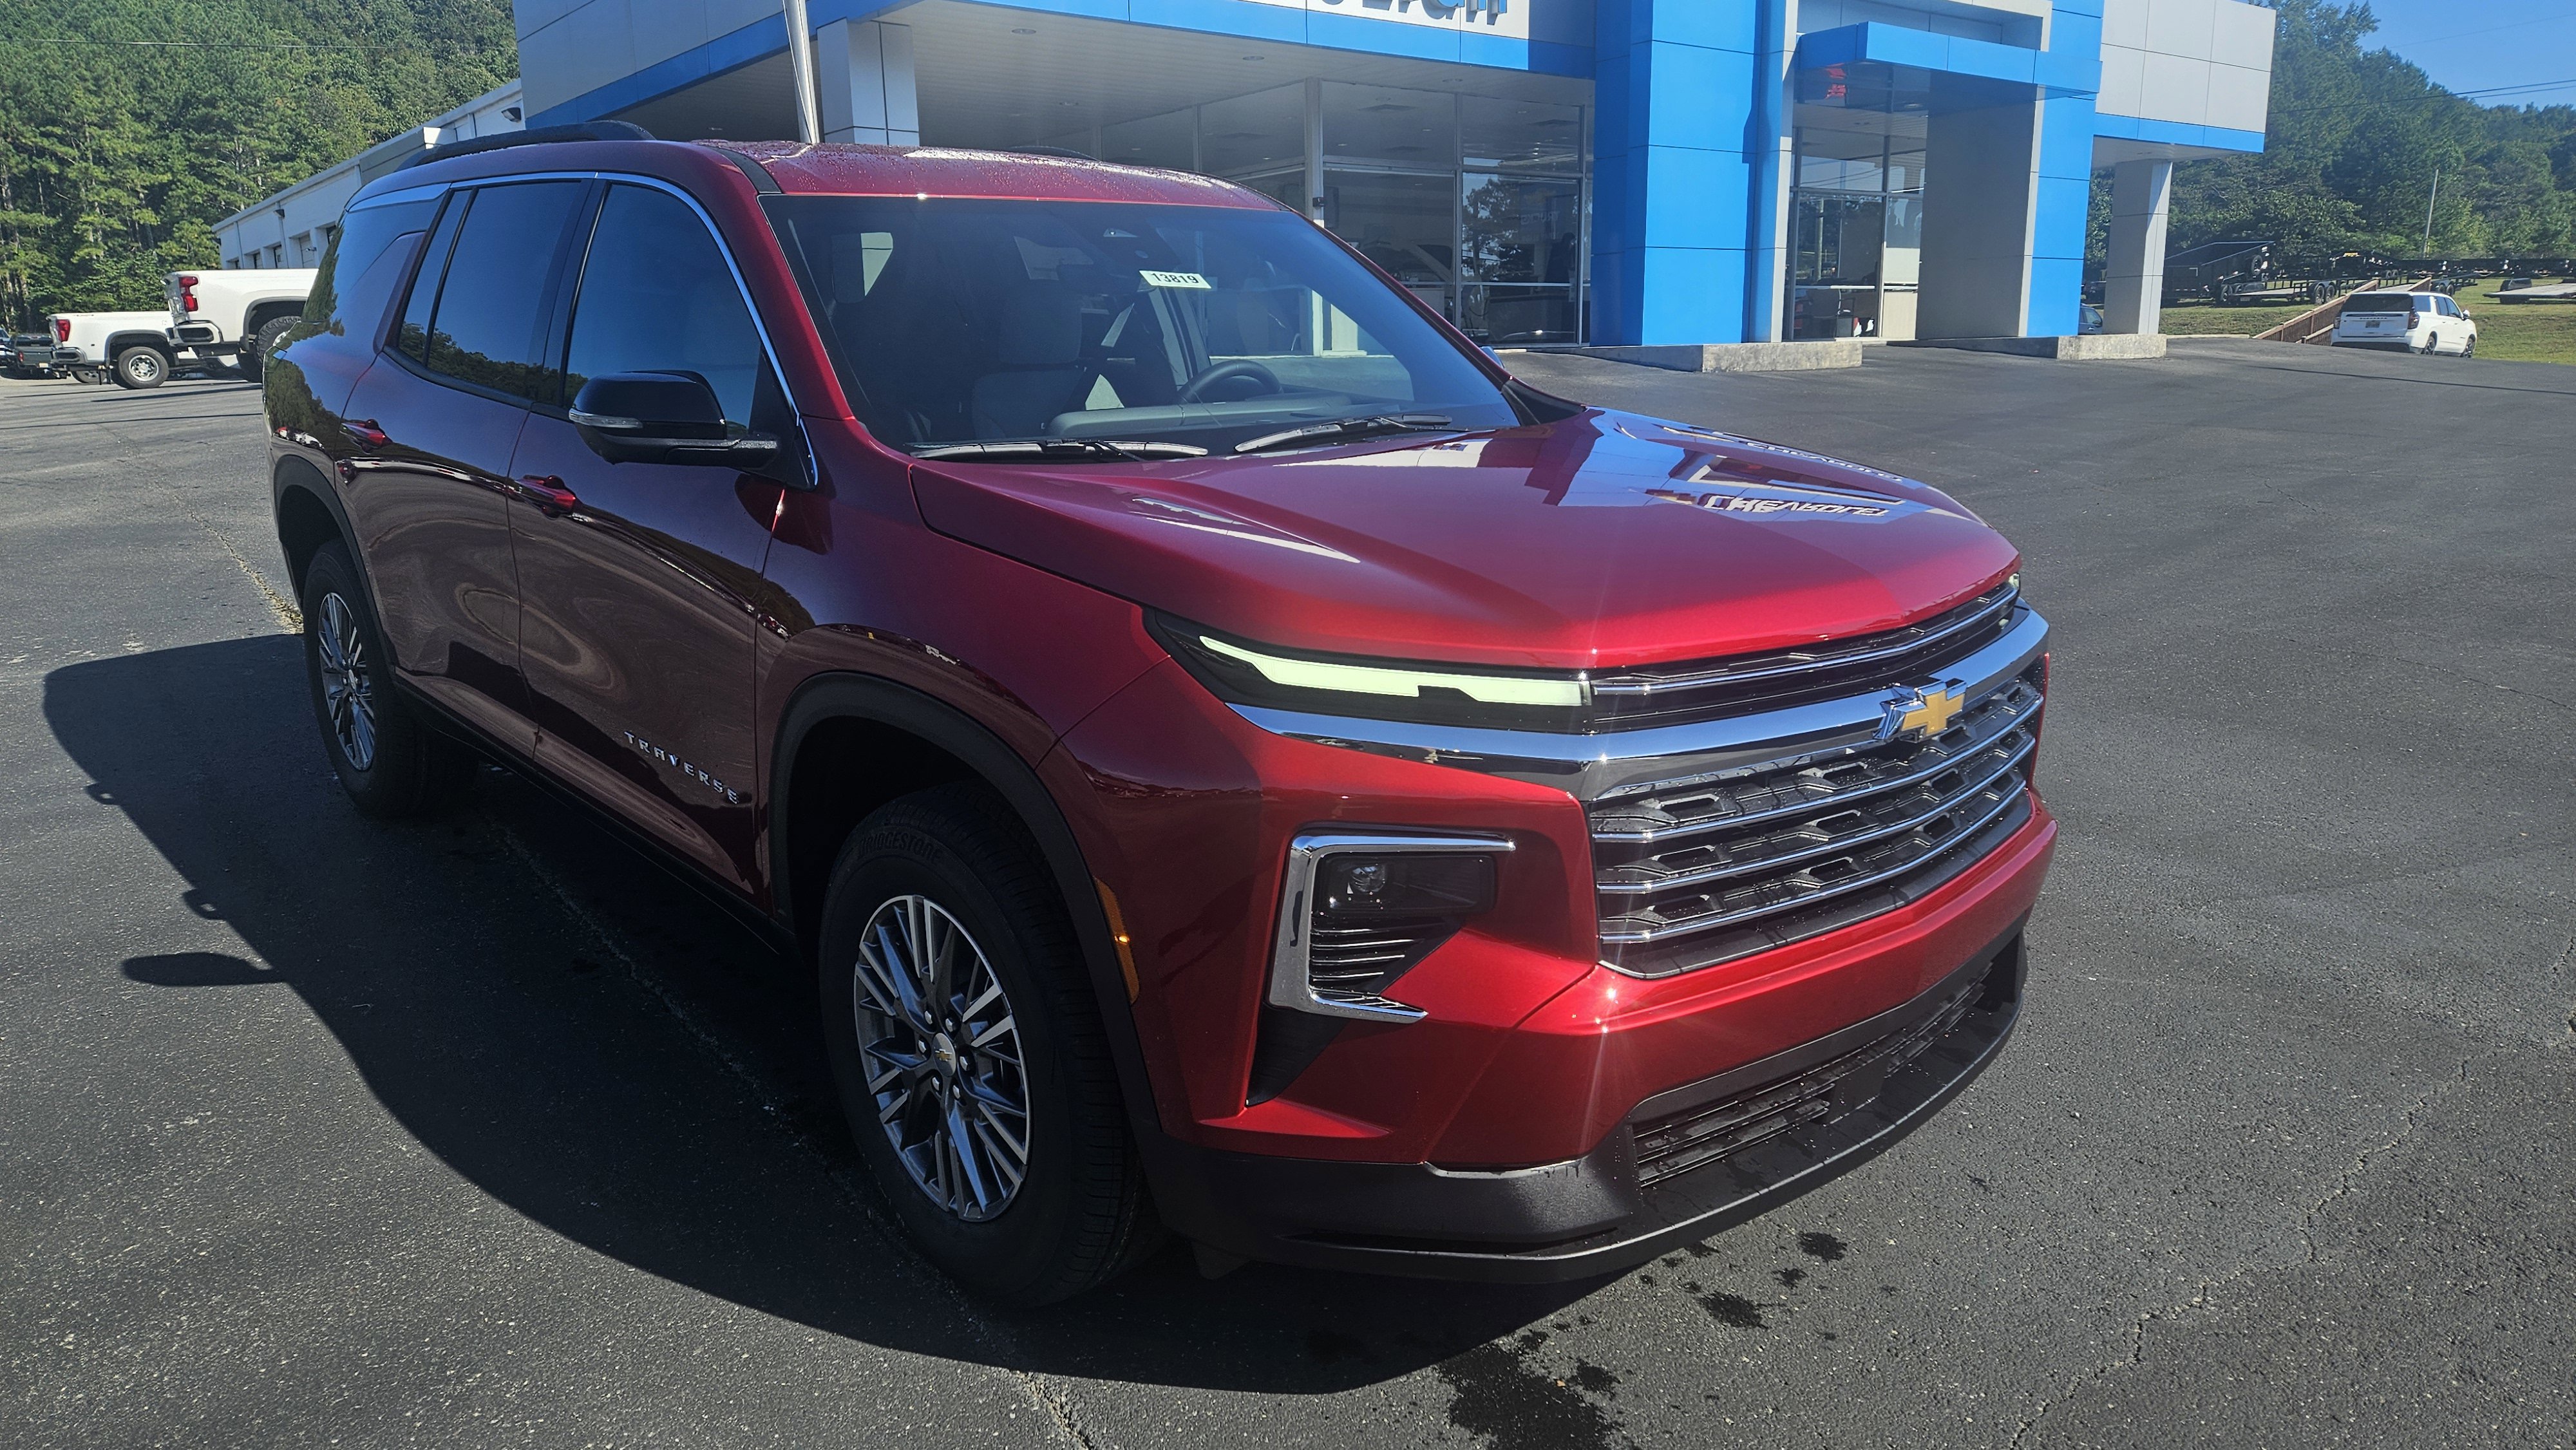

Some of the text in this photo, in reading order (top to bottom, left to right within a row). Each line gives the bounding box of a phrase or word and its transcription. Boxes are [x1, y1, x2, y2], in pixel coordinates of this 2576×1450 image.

[1150, 272, 1199, 284] 13819
[623, 731, 739, 804] TRAVERSE
[858, 831, 942, 865] BRIDGESTONE
